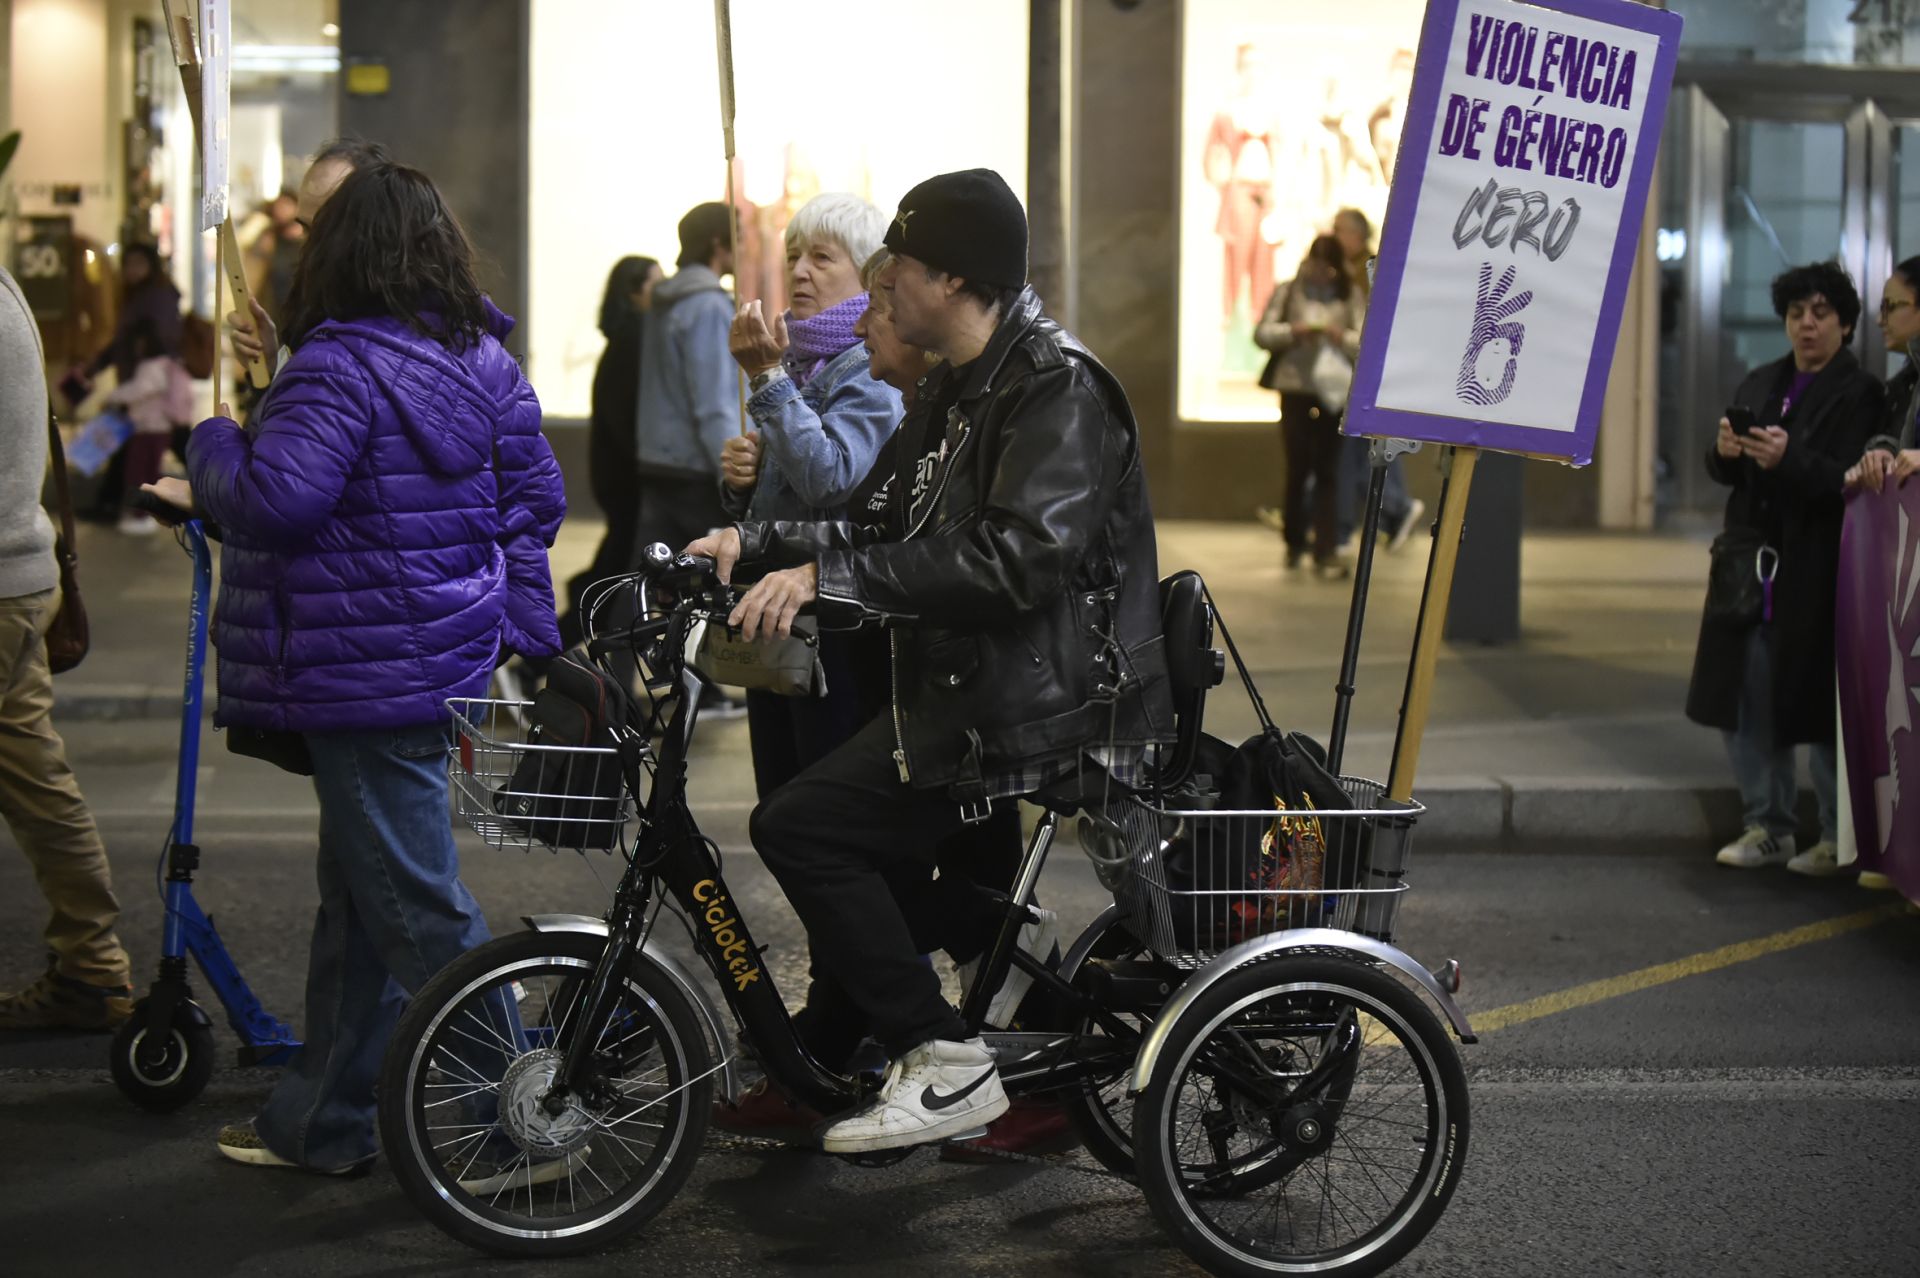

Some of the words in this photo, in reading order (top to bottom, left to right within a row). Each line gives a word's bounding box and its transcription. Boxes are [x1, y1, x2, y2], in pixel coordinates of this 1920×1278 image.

[1465, 13, 1638, 111] VIOLENCIA
[1438, 93, 1491, 161] DE
[1494, 95, 1628, 189] GÉNERO
[1452, 177, 1581, 263] CERO
[692, 879, 760, 992] Ciclotek
